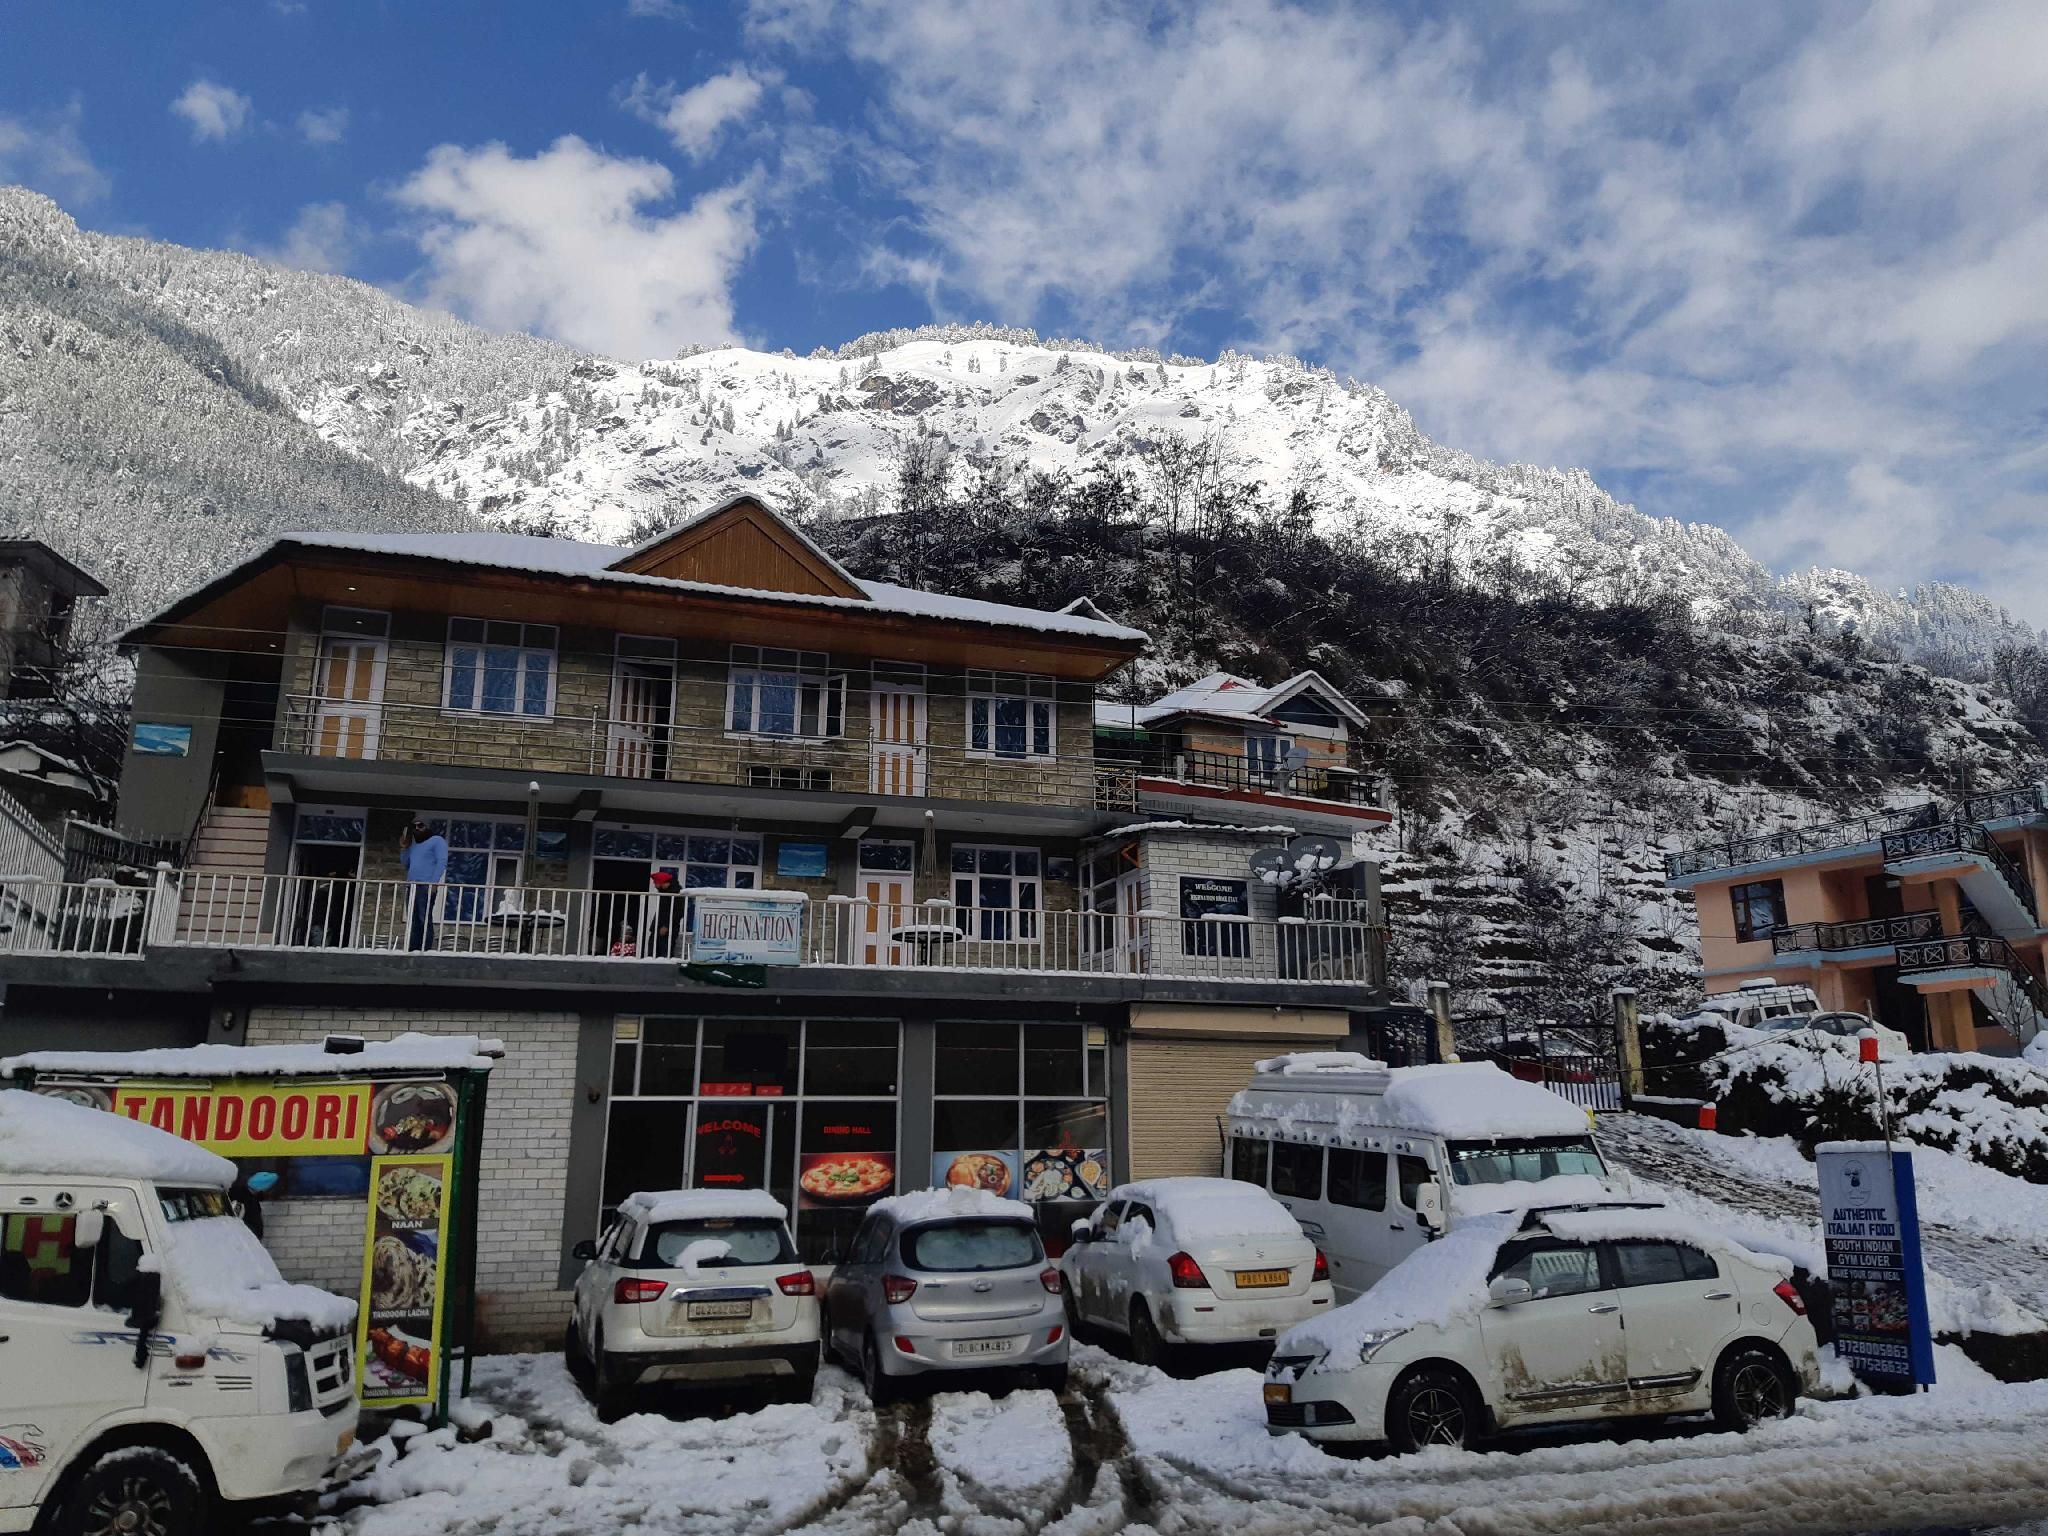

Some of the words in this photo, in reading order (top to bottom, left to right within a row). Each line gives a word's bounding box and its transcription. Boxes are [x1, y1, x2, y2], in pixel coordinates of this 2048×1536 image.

[1195, 883, 1233, 893] WELCOME
[703, 913, 739, 941] HIGH
[742, 914, 794, 942] NATION
[124, 1094, 359, 1141] TANDOORI
[697, 1119, 761, 1138] WELCOME
[1833, 1208, 1887, 1221] AUTHENTIC
[391, 1220, 423, 1229] NAAN
[1828, 1222, 1865, 1236] ITALIAN
[1869, 1223, 1896, 1237] FOOD
[1832, 1239, 1861, 1252] SOUTH
[1863, 1241, 1893, 1253] INDIAN
[1838, 1254, 1858, 1266] GYM
[1860, 1255, 1890, 1267] LOVER
[1883, 1271, 1901, 1281] MEAL
[372, 1310, 407, 1320] TANDOORI
